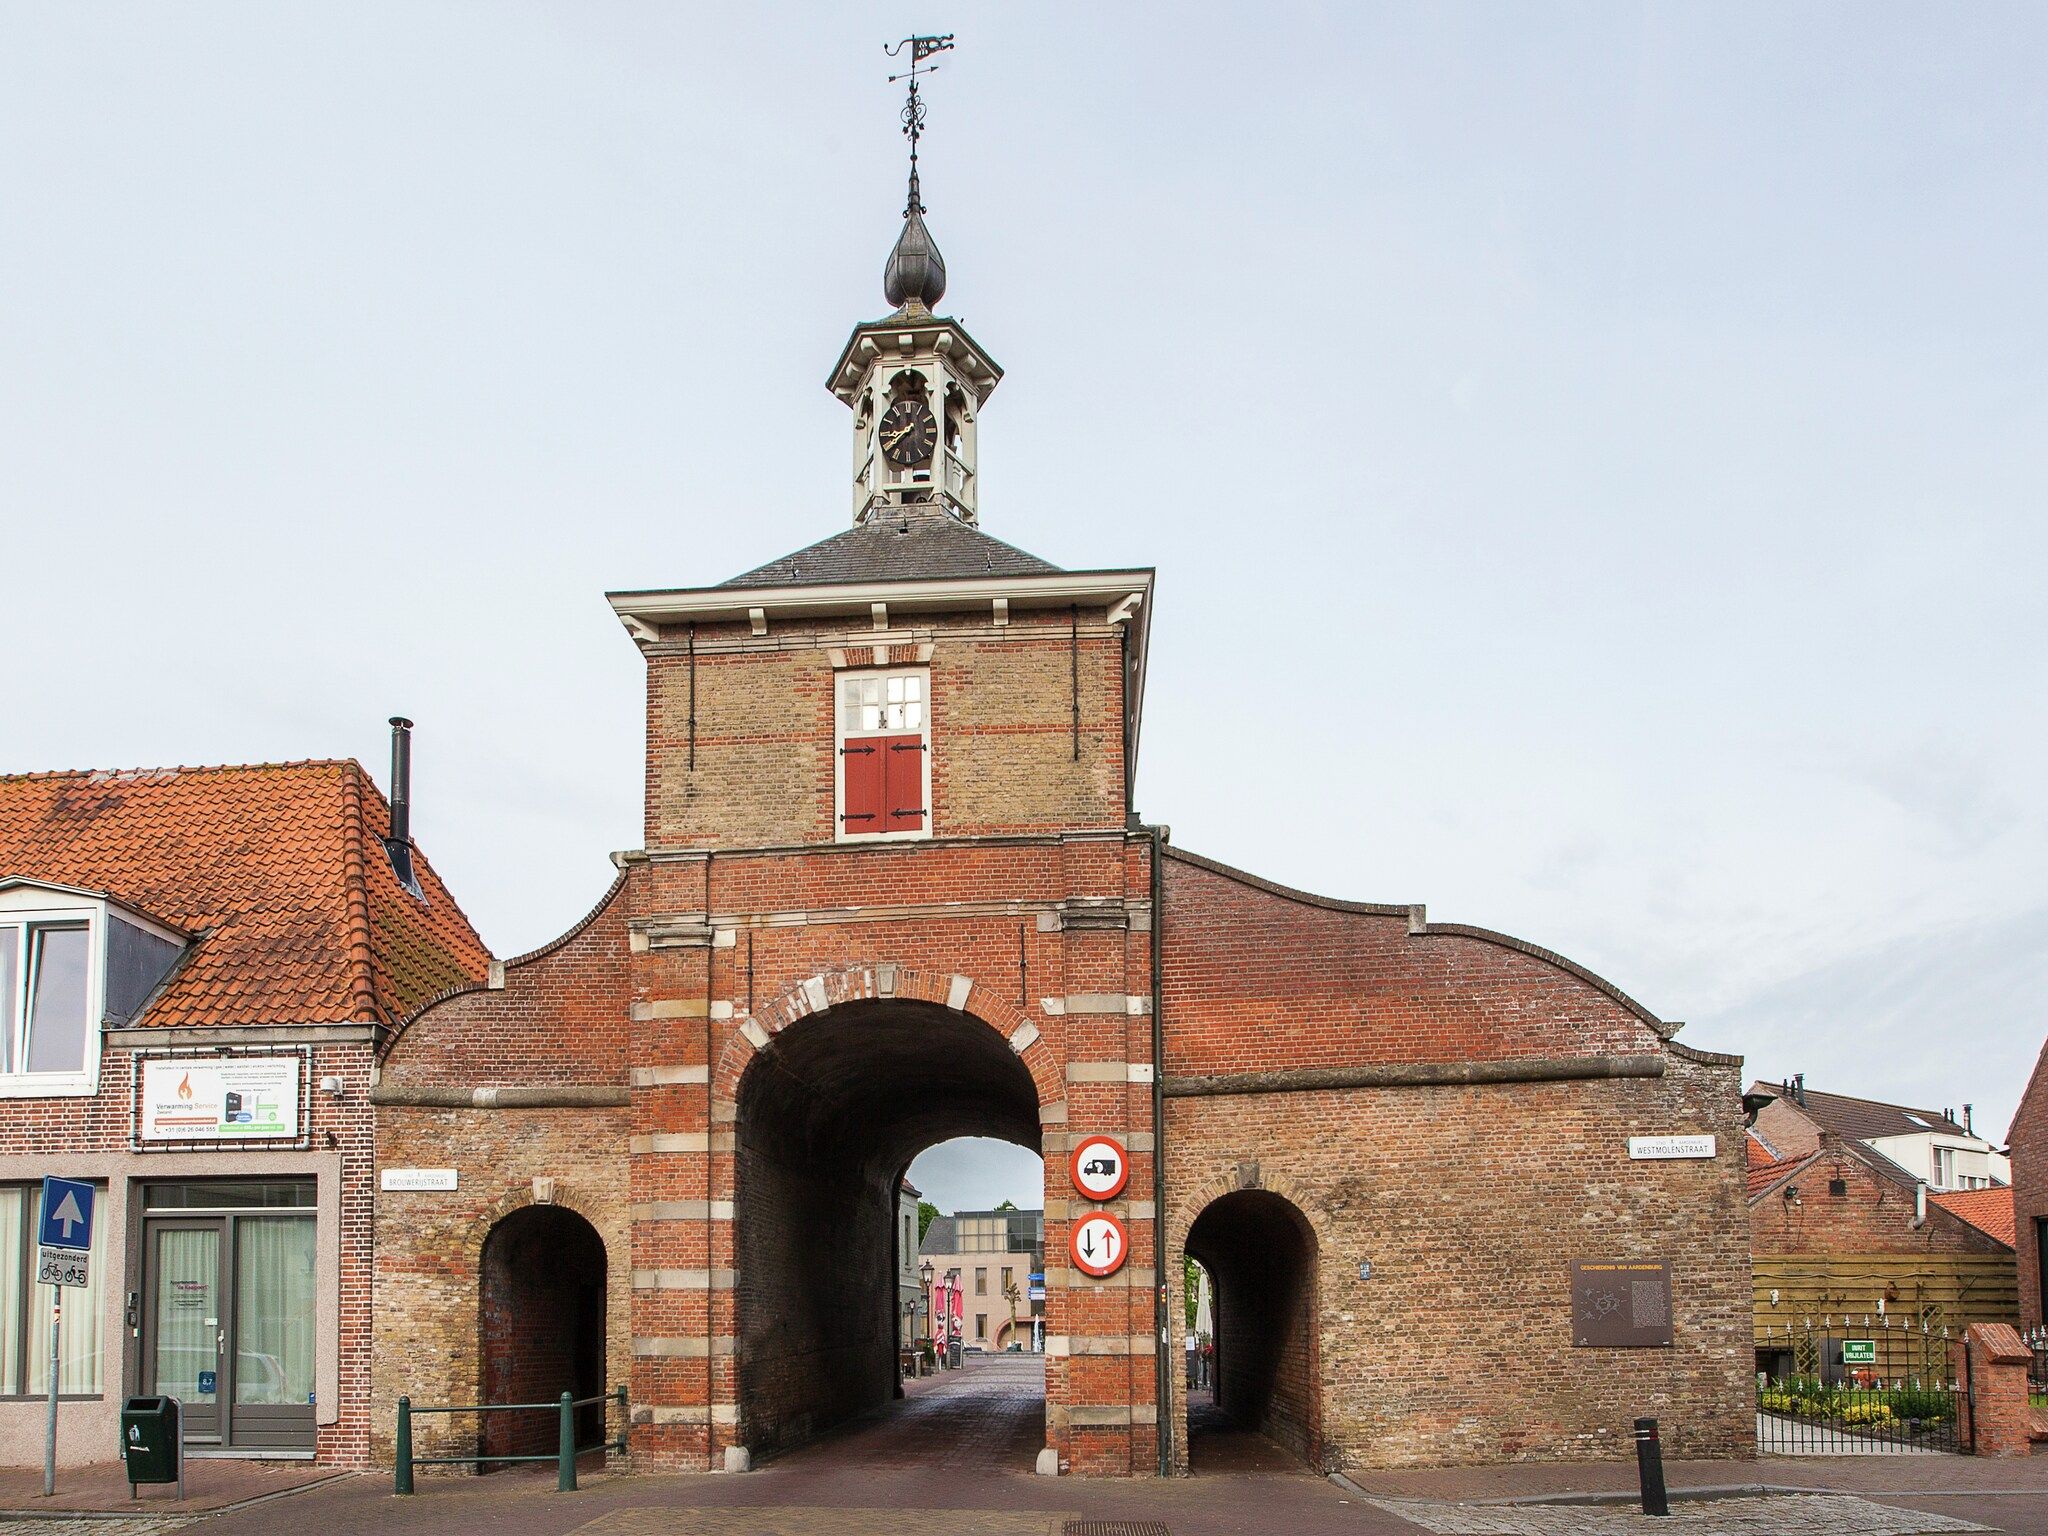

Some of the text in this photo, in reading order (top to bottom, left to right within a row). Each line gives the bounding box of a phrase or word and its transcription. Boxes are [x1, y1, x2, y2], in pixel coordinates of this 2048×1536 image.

[1637, 1145, 1709, 1155] WESTMOLENSTRAAT
[389, 1178, 448, 1187] BROUWERIJSTRAAT
[42, 1251, 88, 1263] uitgezonderd
